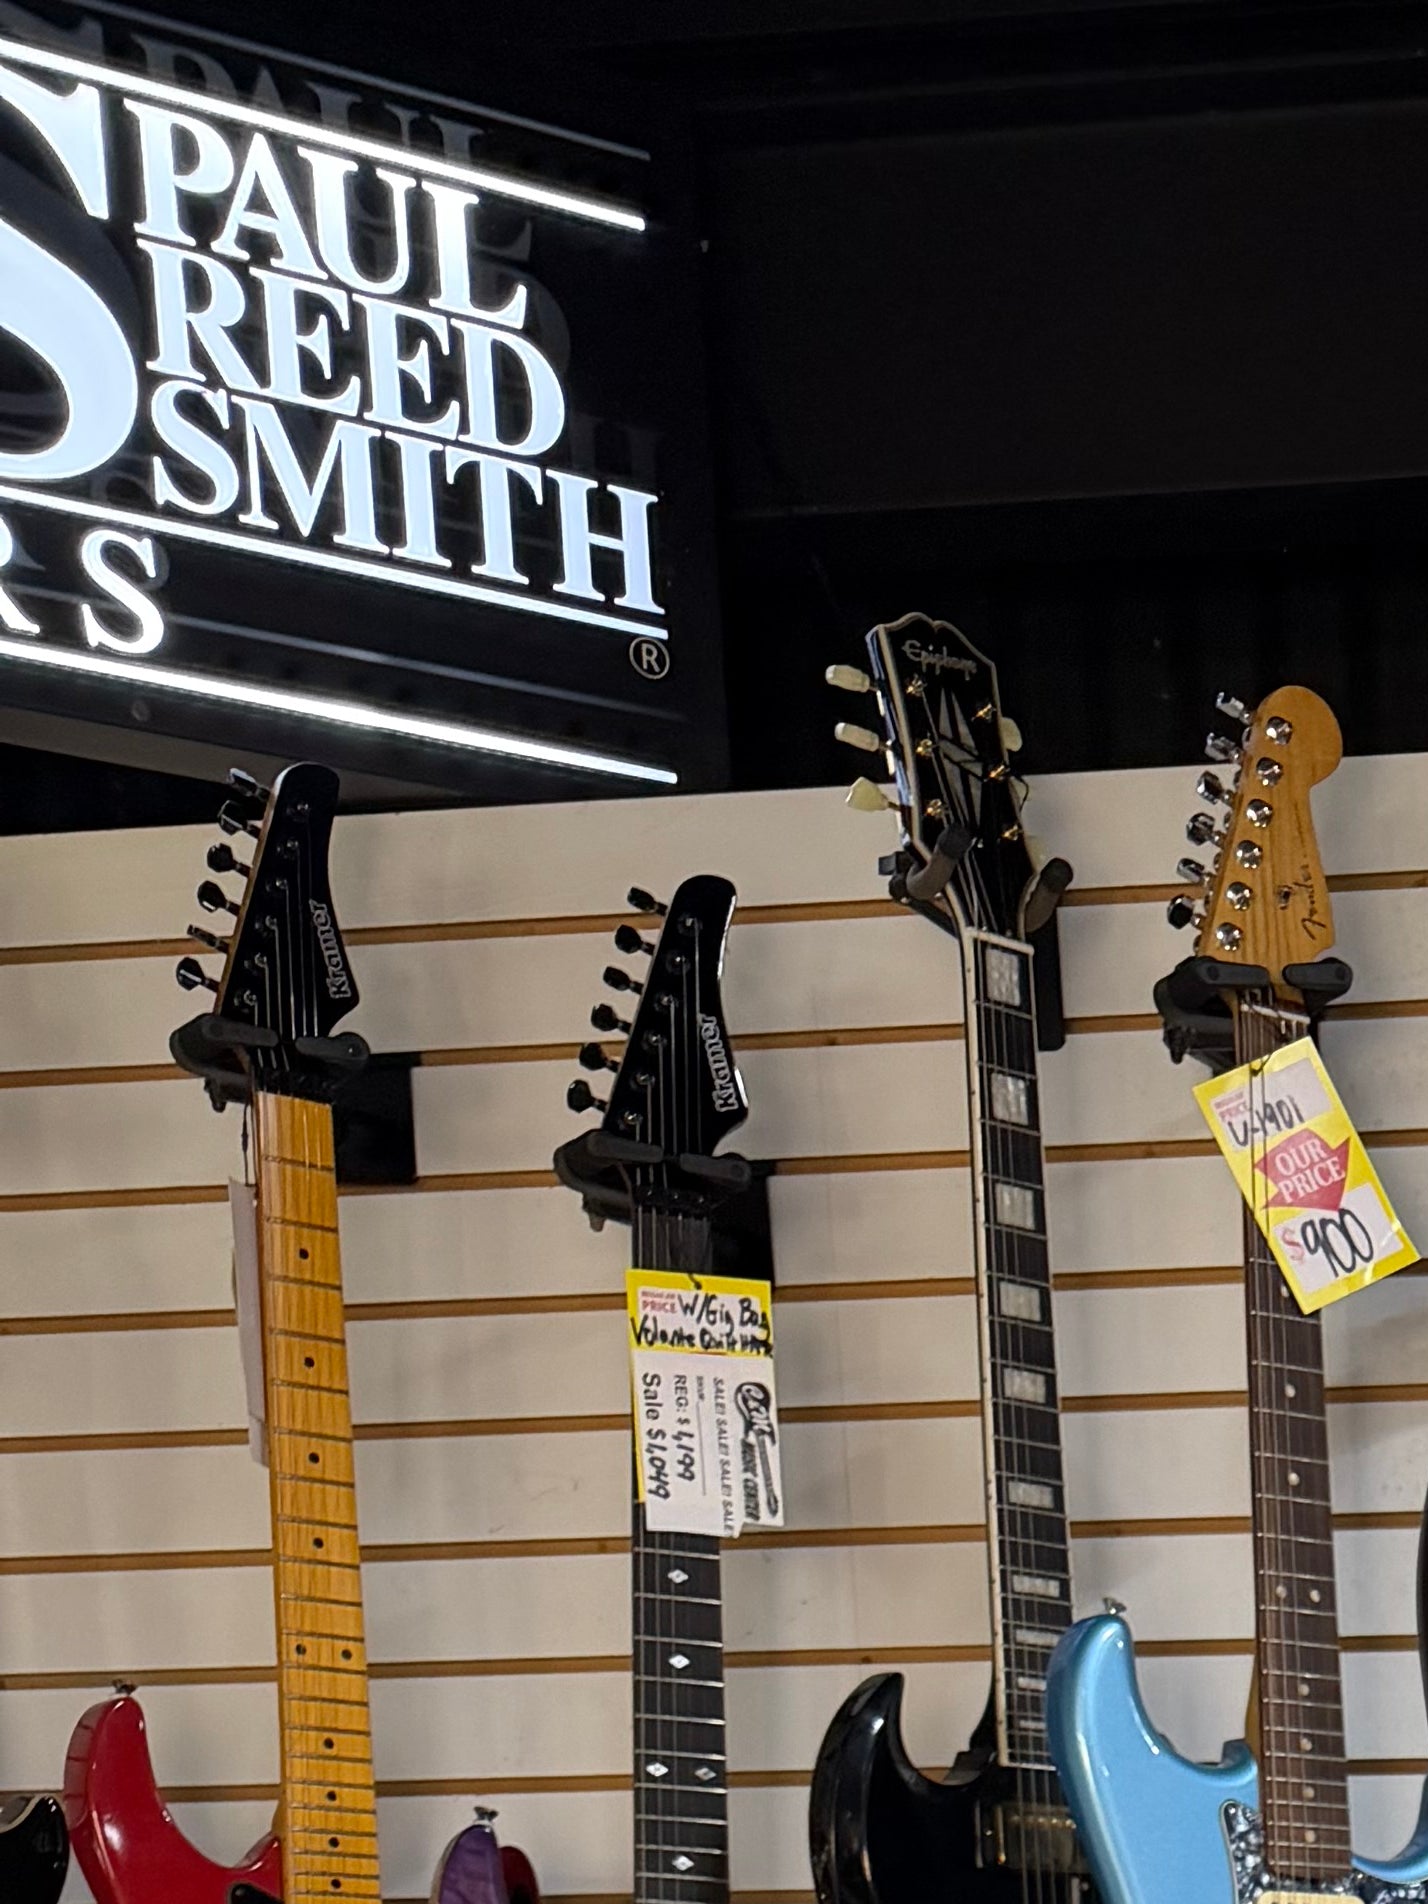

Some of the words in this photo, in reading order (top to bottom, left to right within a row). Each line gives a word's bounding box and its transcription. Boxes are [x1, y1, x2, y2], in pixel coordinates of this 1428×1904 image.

[123, 97, 528, 329] PAUL
[137, 239, 565, 457] REED
[151, 379, 666, 615] SMITH
[309, 900, 352, 999] Kramer
[698, 1013, 740, 1114] Kramer
[1274, 1137, 1329, 1177] OUR
[1277, 1156, 1347, 1205] PRICE
[1280, 1207, 1374, 1278] $900
[641, 1299, 678, 1315] PRICE
[642, 1372, 664, 1421] Sale
[673, 1373, 690, 1413] REG:
